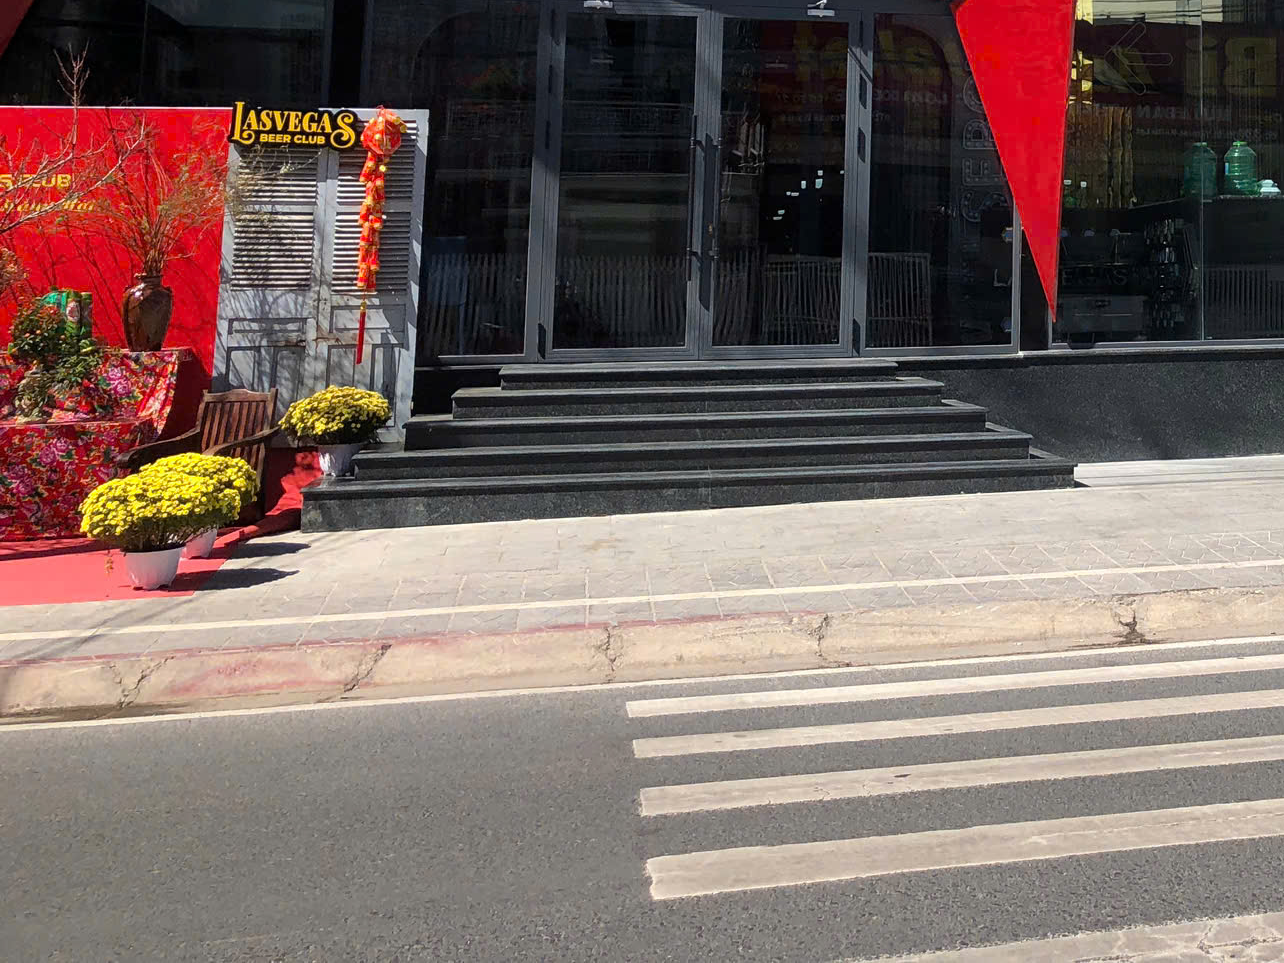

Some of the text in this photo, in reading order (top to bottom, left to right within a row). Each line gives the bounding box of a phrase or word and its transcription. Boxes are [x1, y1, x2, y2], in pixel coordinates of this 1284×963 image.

[231, 101, 356, 149] LASVEGAS
[259, 133, 326, 145] BEER CLUB
